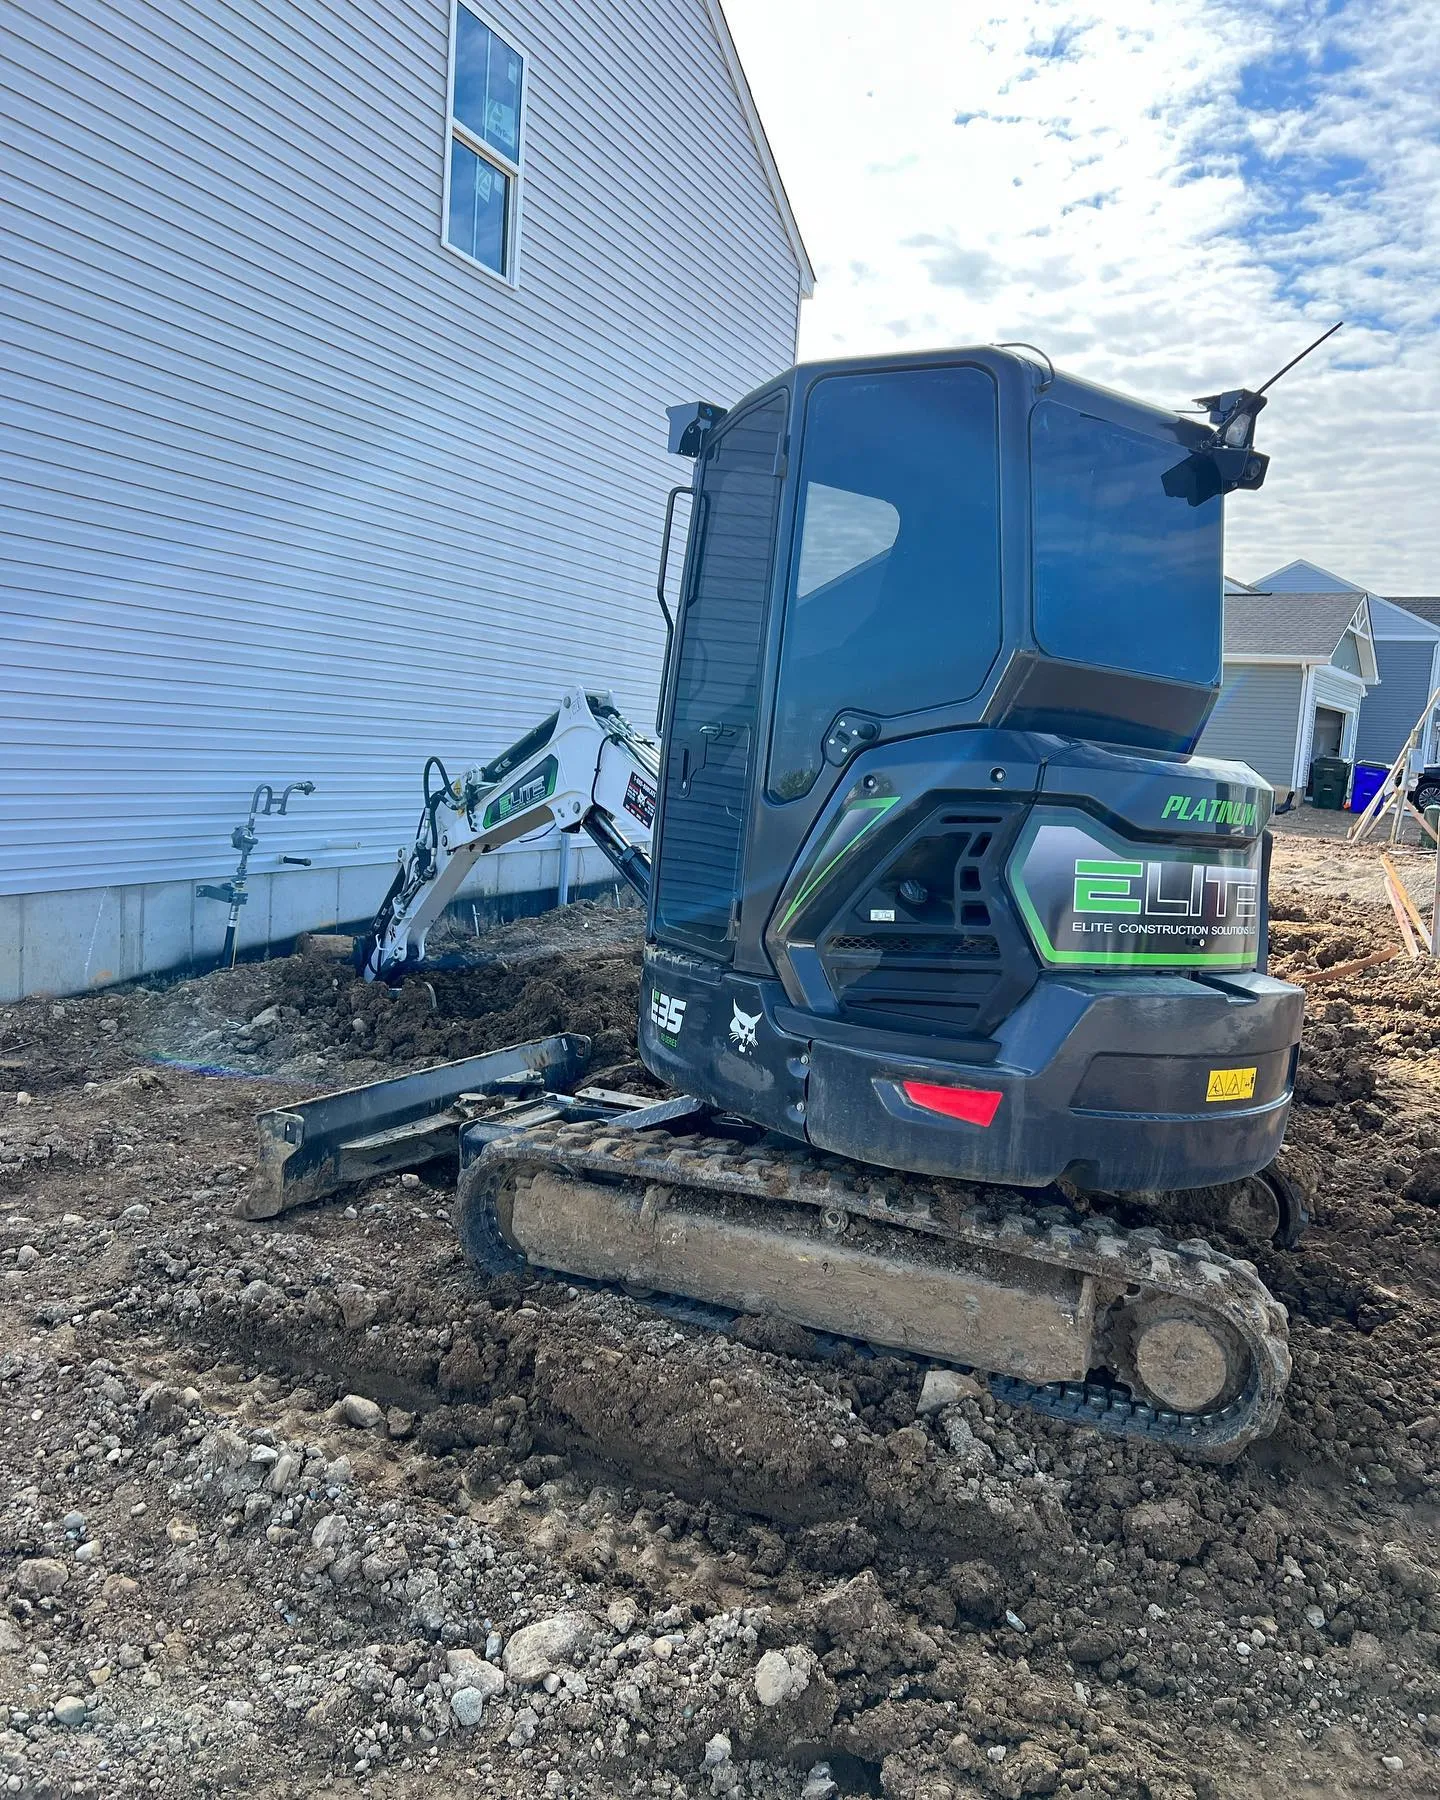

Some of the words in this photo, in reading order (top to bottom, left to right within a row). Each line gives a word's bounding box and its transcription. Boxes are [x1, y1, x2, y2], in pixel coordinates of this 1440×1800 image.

[499, 775, 546, 815] ELITE
[1161, 795, 1256, 826] PLATINUM
[1073, 858, 1258, 918] ELITE
[1072, 922, 1113, 934] ELITE
[1118, 923, 1209, 936] CONSTRUCTION
[1211, 925, 1249, 936] SOLUTIONS
[651, 988, 687, 1034] E35
